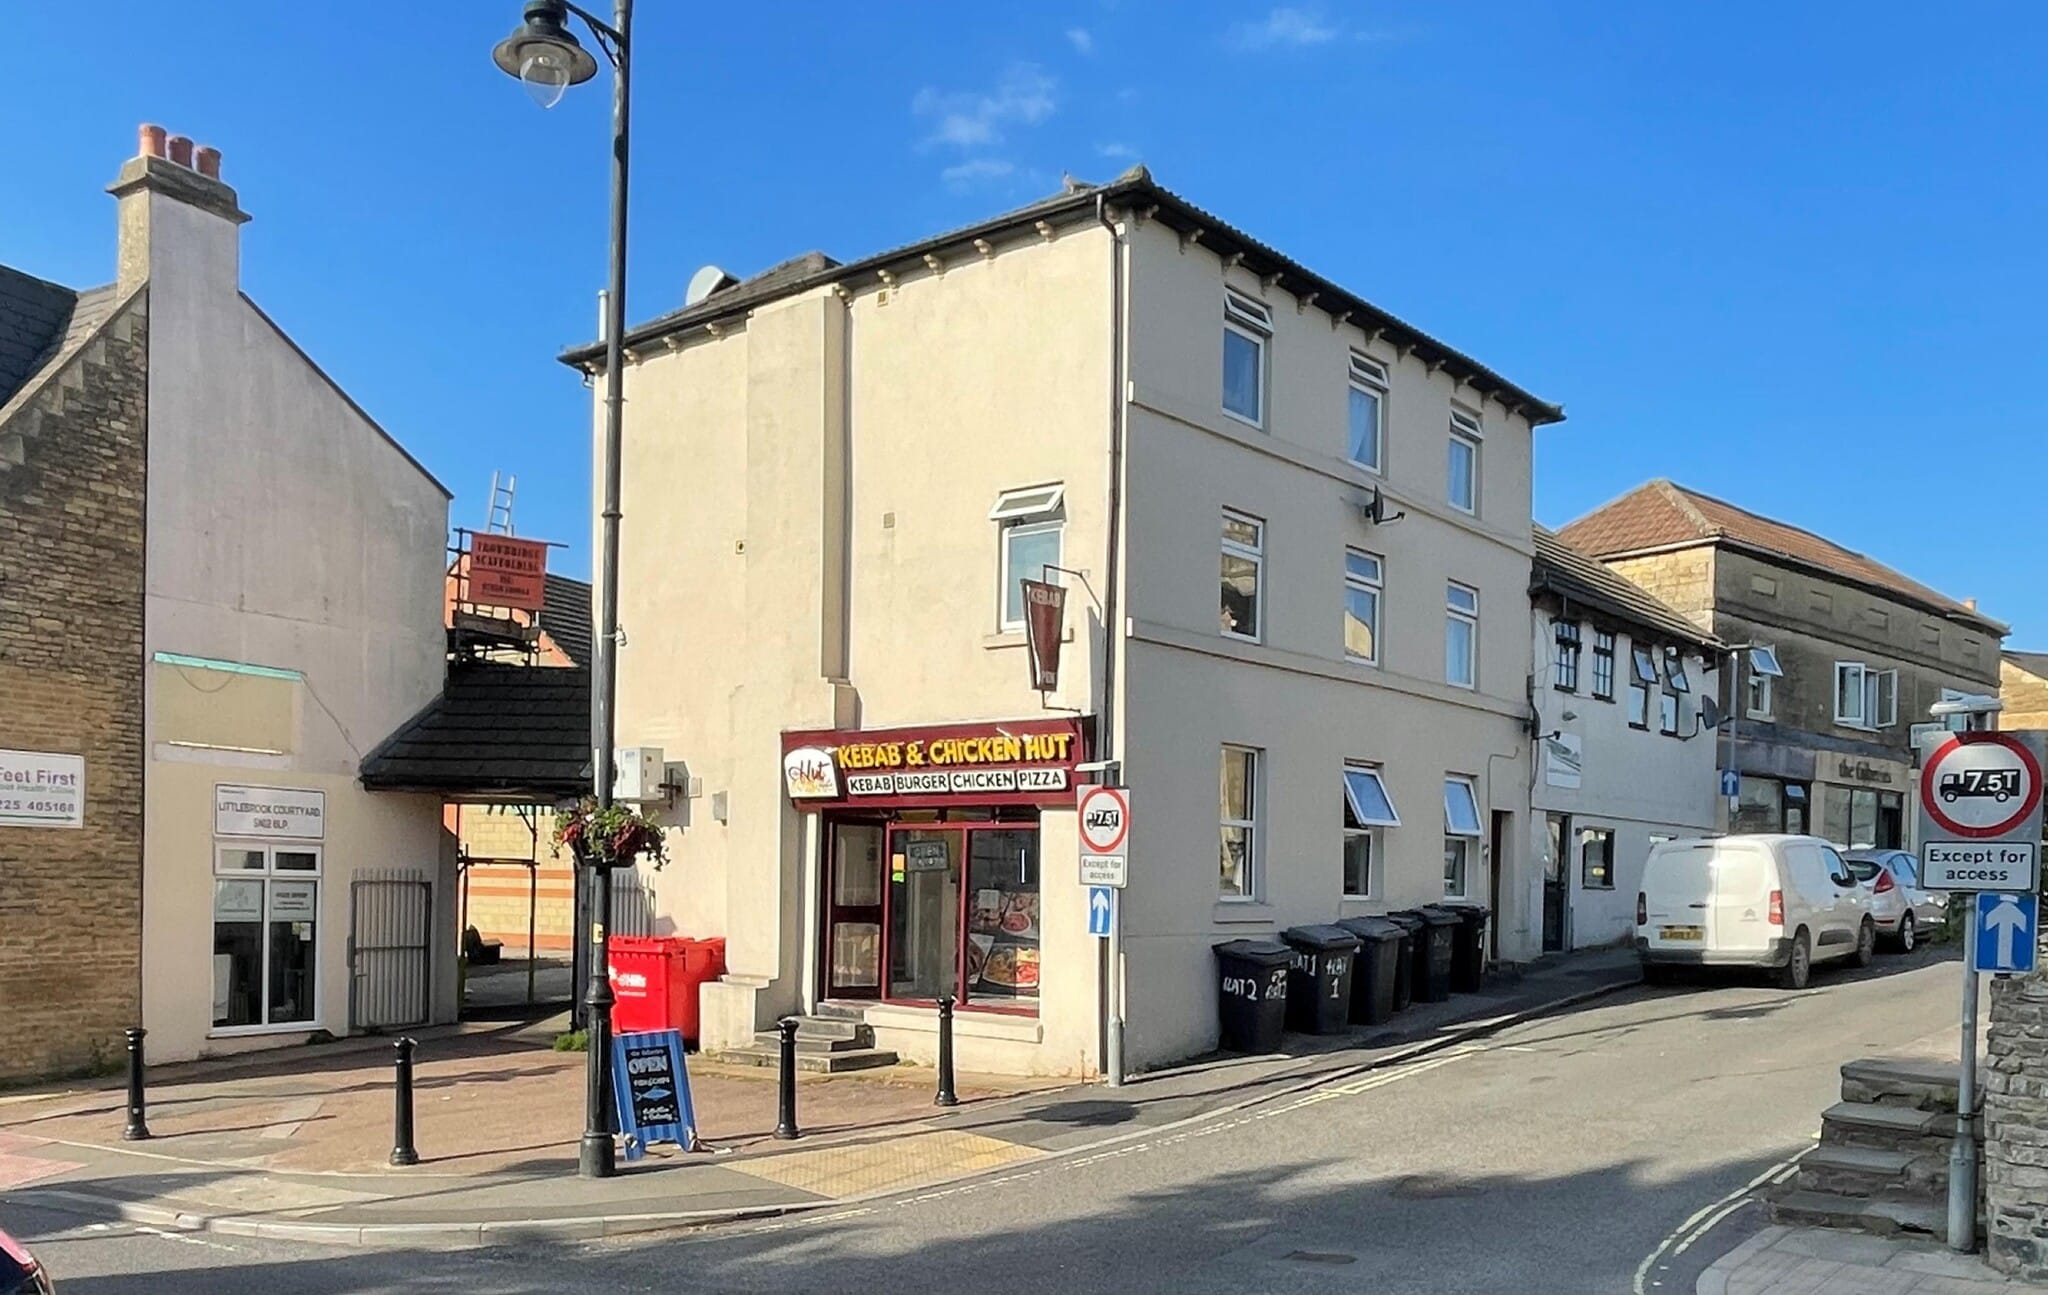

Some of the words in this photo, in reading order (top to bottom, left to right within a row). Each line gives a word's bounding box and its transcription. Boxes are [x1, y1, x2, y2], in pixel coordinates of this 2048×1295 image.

[838, 743, 902, 769] KEBAB
[906, 743, 925, 766] &
[929, 736, 1021, 765] CHICKEN
[1022, 734, 1070, 761] HUT
[36, 769, 75, 786] First
[850, 776, 891, 792] KEBAB
[896, 773, 947, 790] BURGER
[952, 771, 1013, 789] CHICKEN
[1019, 770, 1062, 786] PIZZA
[1966, 771, 2018, 793] 7.5T
[0, 799, 20, 810] 25
[27, 801, 75, 813] 405168
[273, 805, 321, 817] COURTYARD
[1083, 858, 1109, 870] Except
[1110, 860, 1122, 869] for
[1930, 848, 1993, 864] Except
[2000, 849, 2027, 863] for
[1089, 872, 1115, 880] access
[1946, 869, 2008, 881] access
[1246, 978, 1258, 1000] 2
[1330, 977, 1340, 999] 1
[628, 1055, 668, 1074] OPEN
